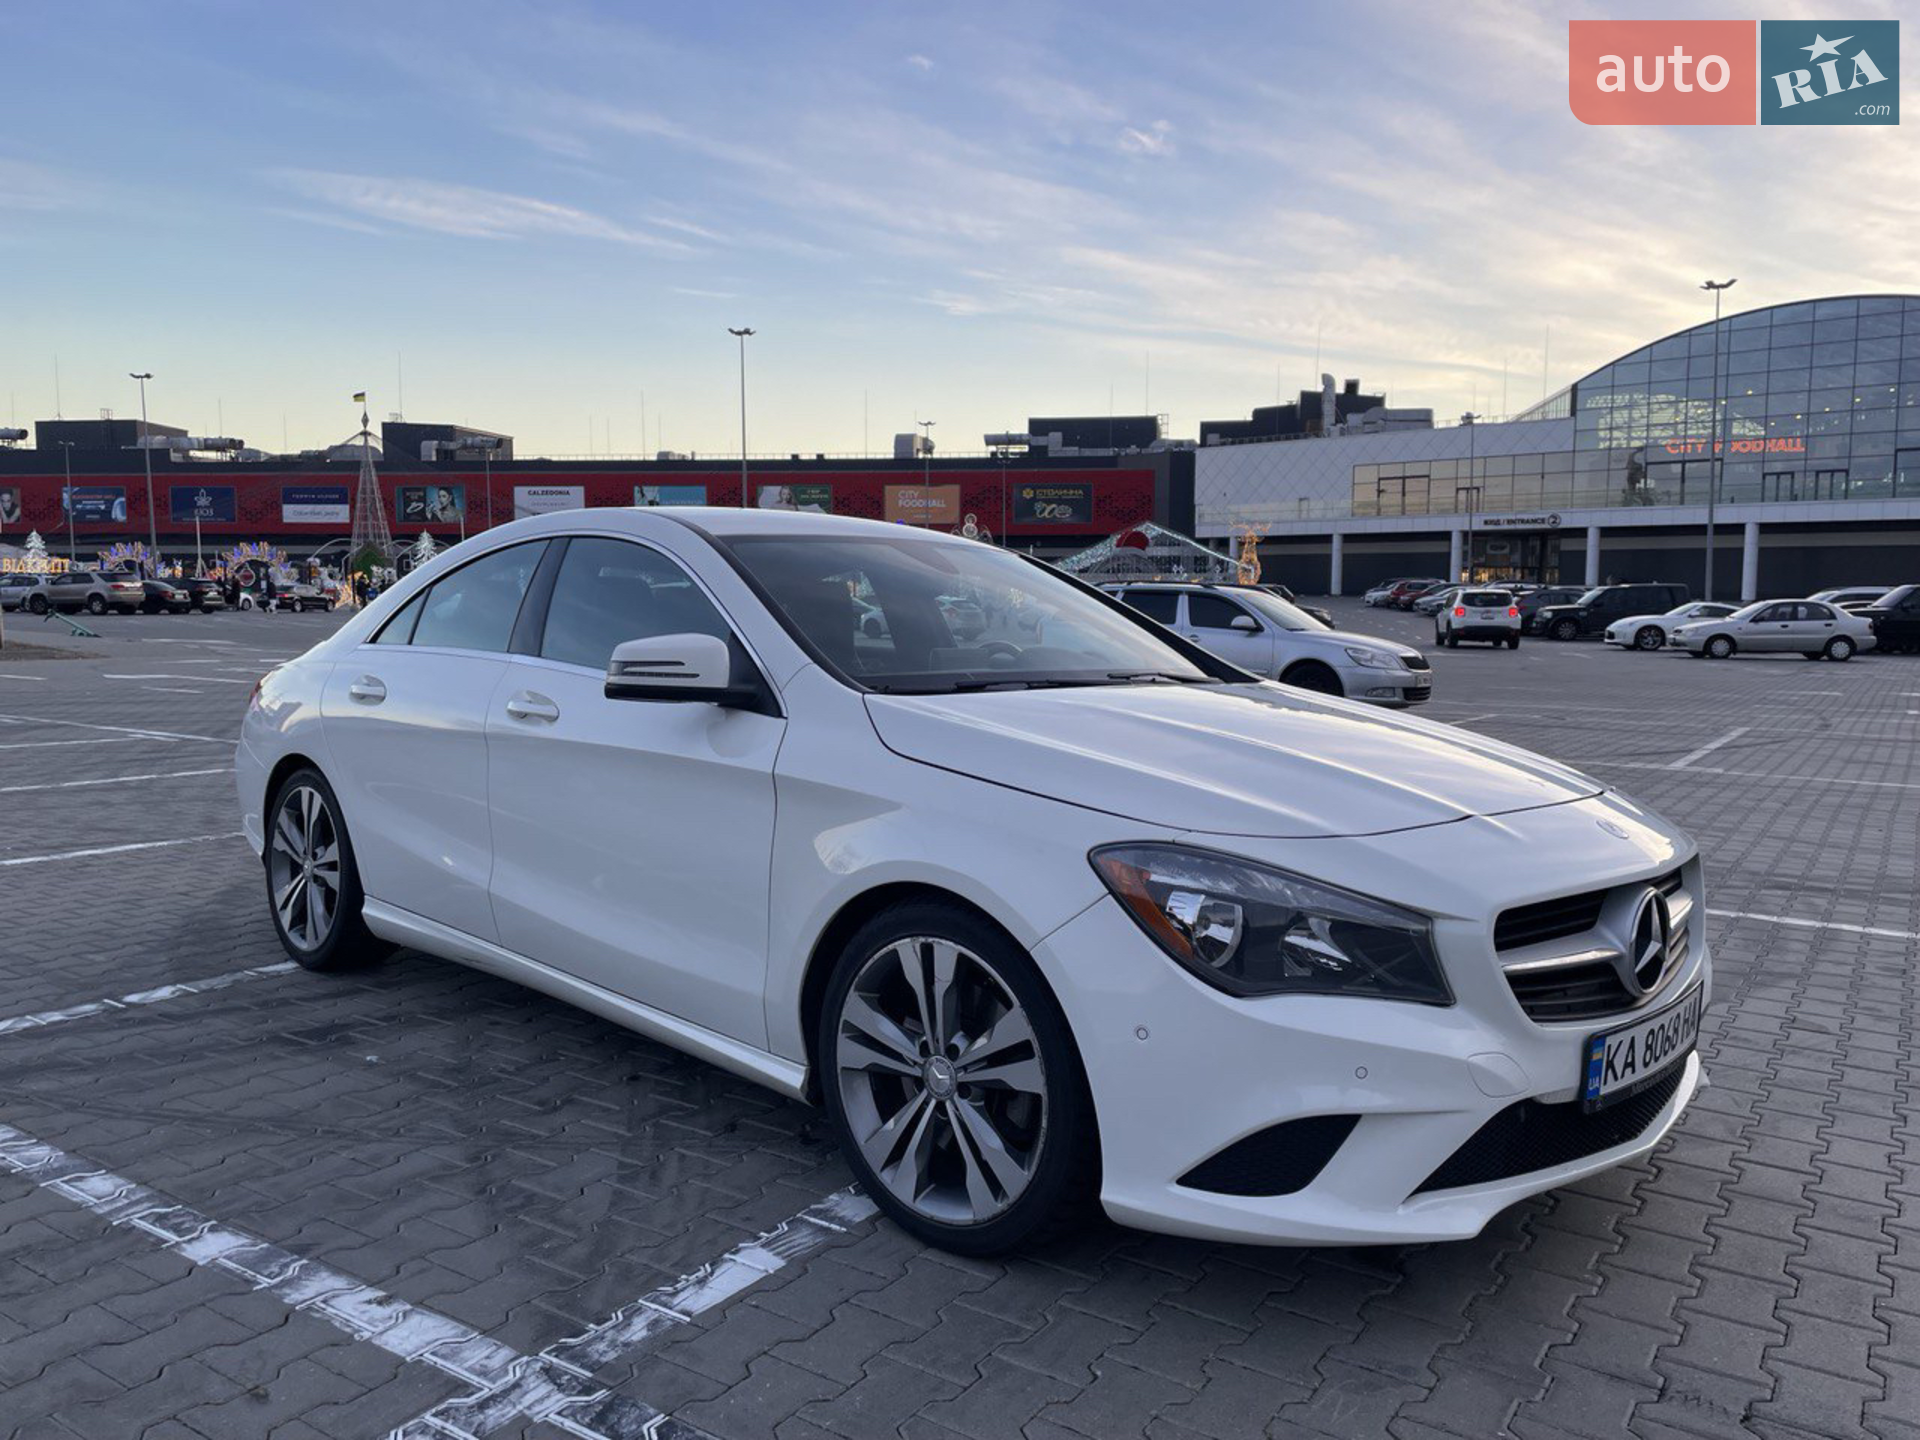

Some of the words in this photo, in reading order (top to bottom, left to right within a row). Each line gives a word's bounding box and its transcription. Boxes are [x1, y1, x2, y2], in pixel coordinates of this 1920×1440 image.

[1665, 437, 1706, 454] CITY
[898, 490, 919, 499] CITY
[1507, 517, 1546, 526] ENTRANCE
[1603, 1036, 1636, 1087] KA
[1642, 1013, 1682, 1069] 8068
